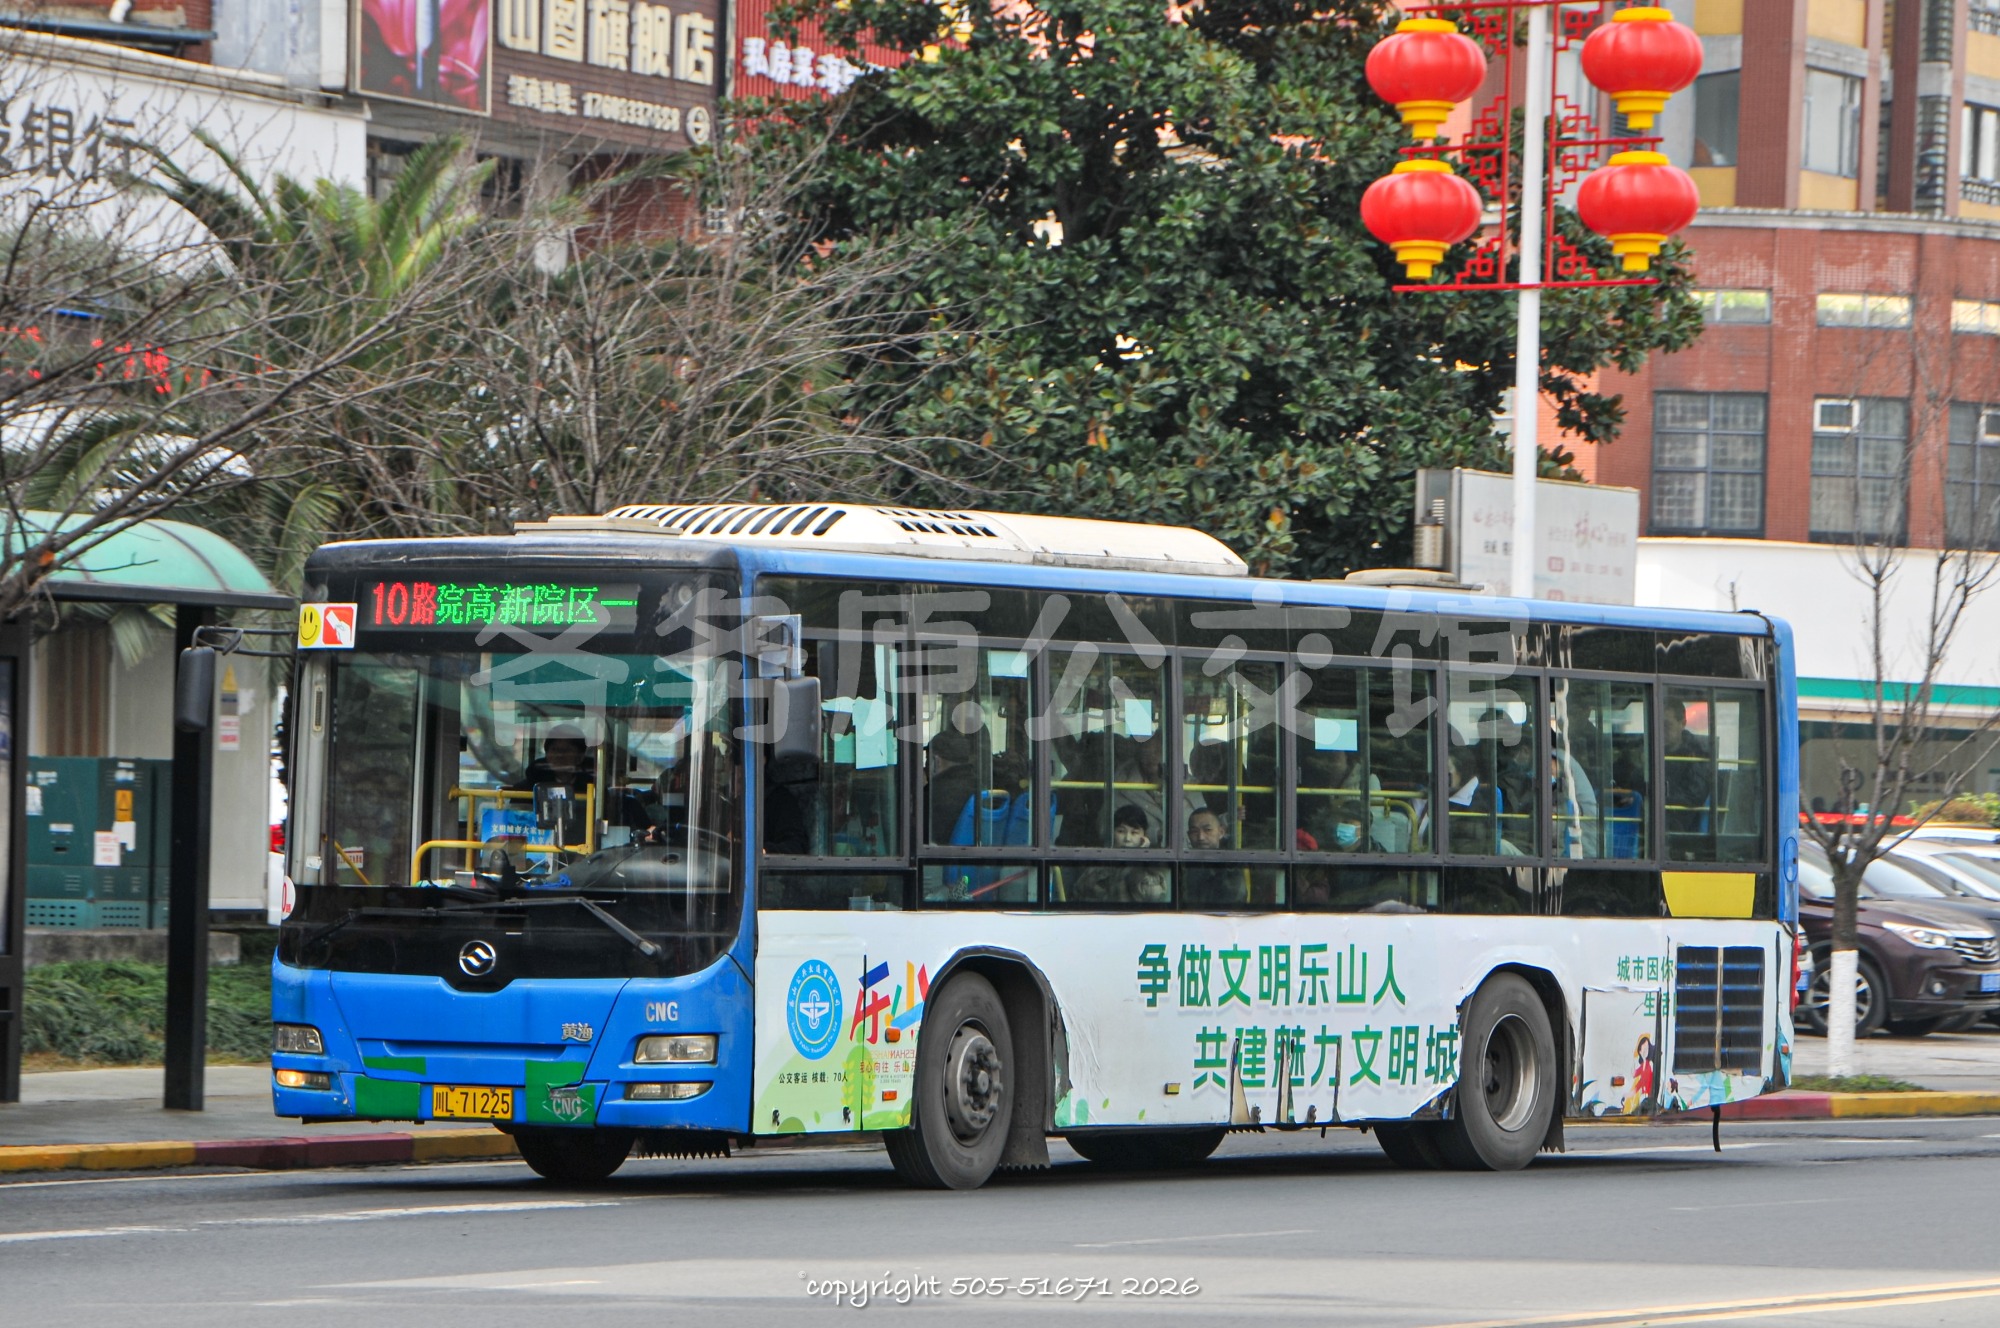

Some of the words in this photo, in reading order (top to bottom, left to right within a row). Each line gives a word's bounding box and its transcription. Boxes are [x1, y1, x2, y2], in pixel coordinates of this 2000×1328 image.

[0, 101, 135, 185] 银行
[1137, 943, 1406, 1008] 争做文明乐山人
[1617, 955, 1677, 982] 城市因你
[645, 1001, 679, 1022] CNG
[1643, 992, 1677, 1017] 生活
[561, 1022, 594, 1043] 黄海
[1193, 1023, 1459, 1090] 共建魅力文明城
[778, 1072, 808, 1085] 公交客运
[833, 1071, 849, 1083] 70人
[551, 1097, 583, 1118] CNG
